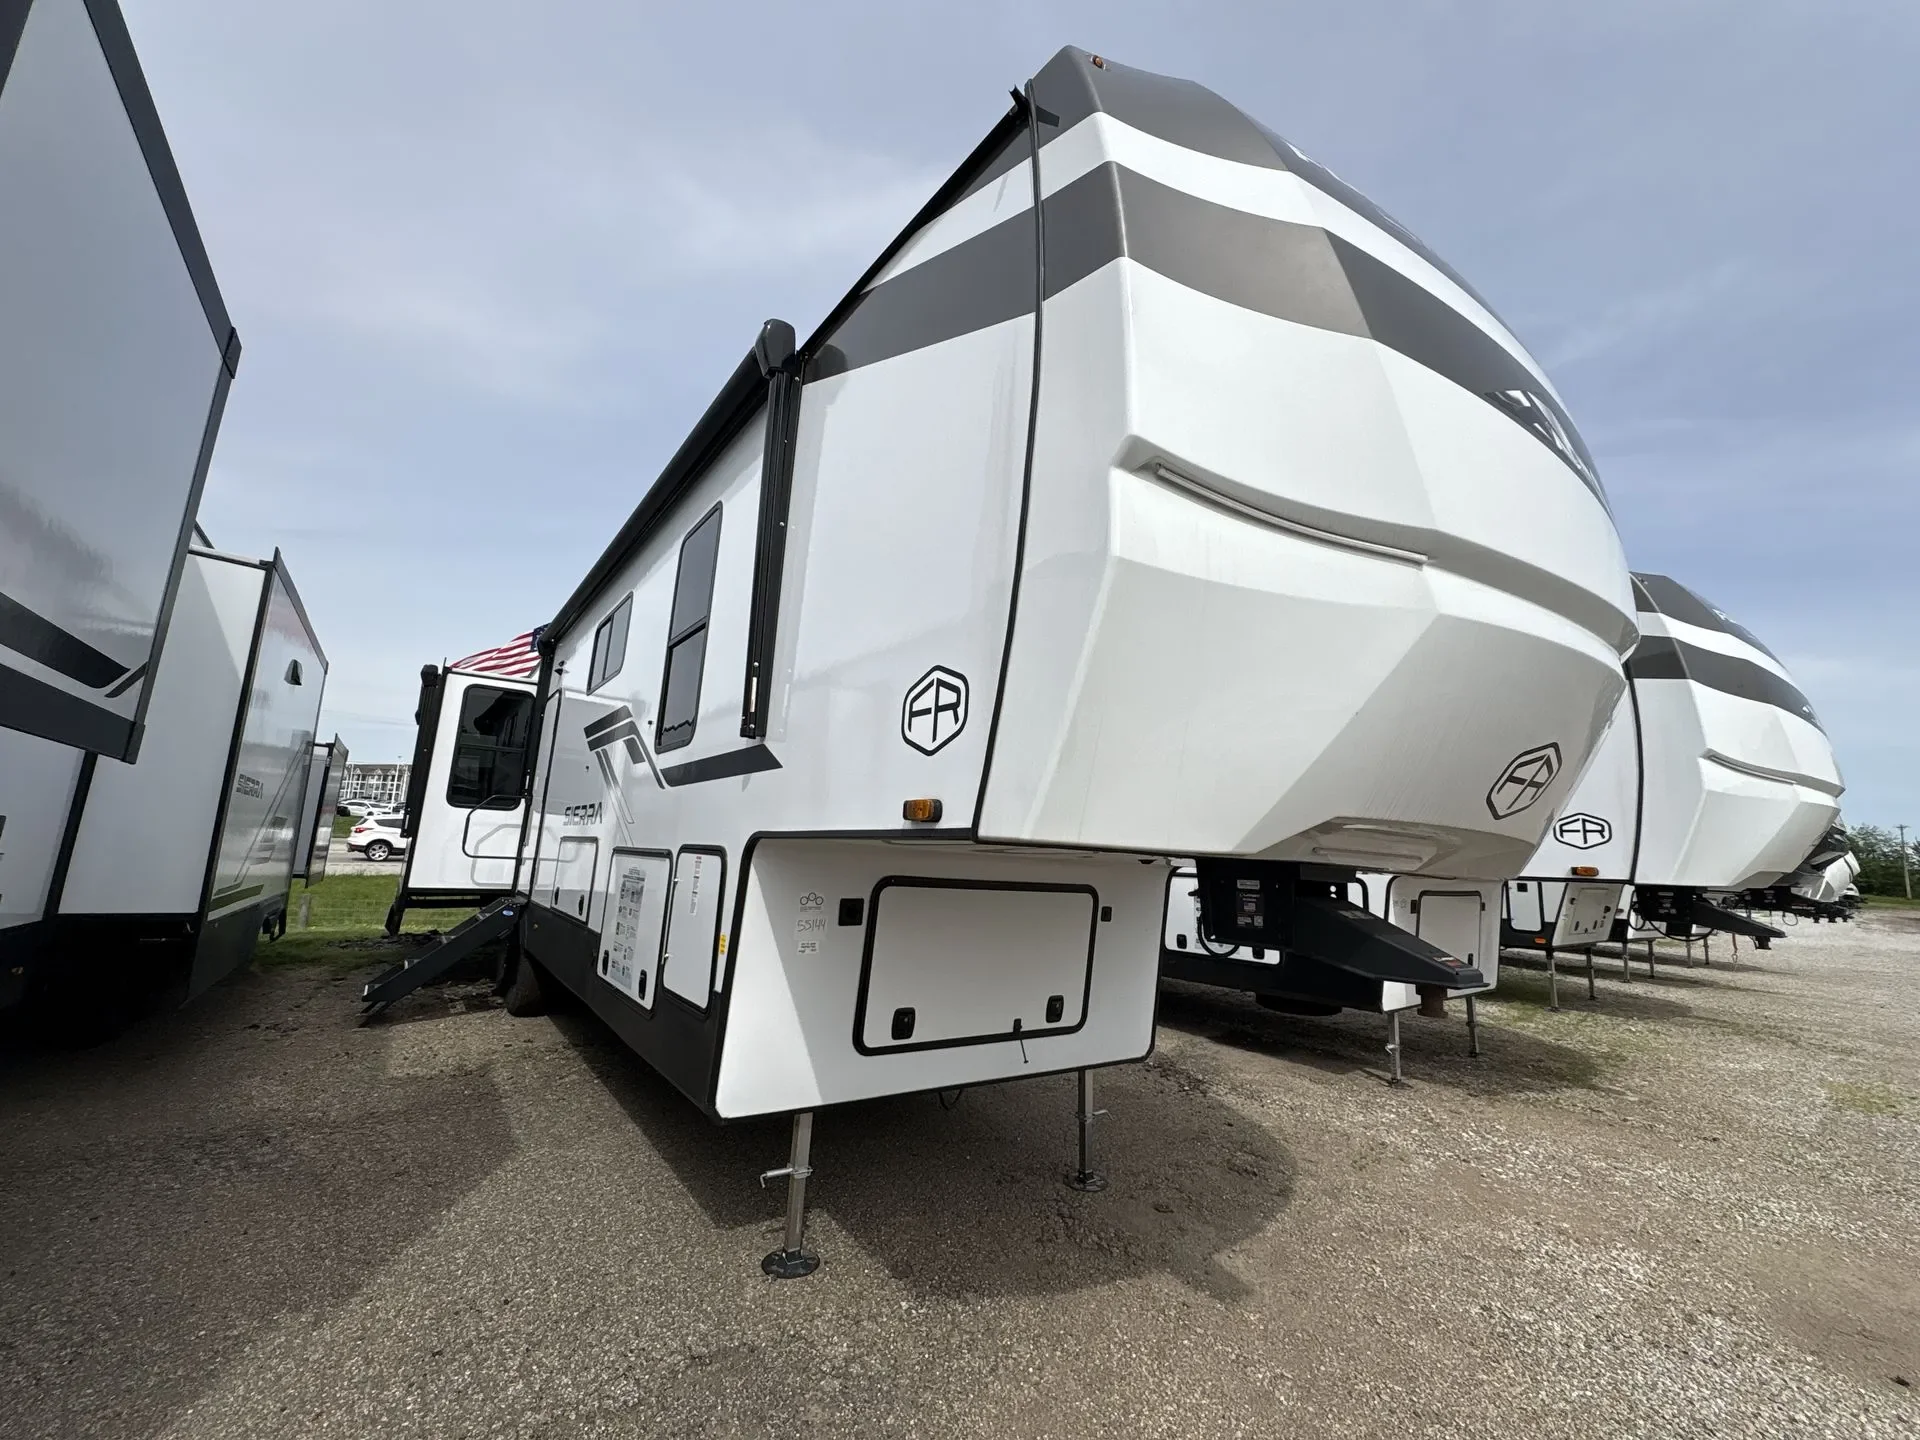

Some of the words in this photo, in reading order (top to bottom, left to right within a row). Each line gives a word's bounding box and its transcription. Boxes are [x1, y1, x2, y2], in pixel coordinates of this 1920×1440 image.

[236, 773, 263, 799] SIERRA
[563, 801, 602, 826] SIERRA
[1559, 817, 1606, 845] FR
